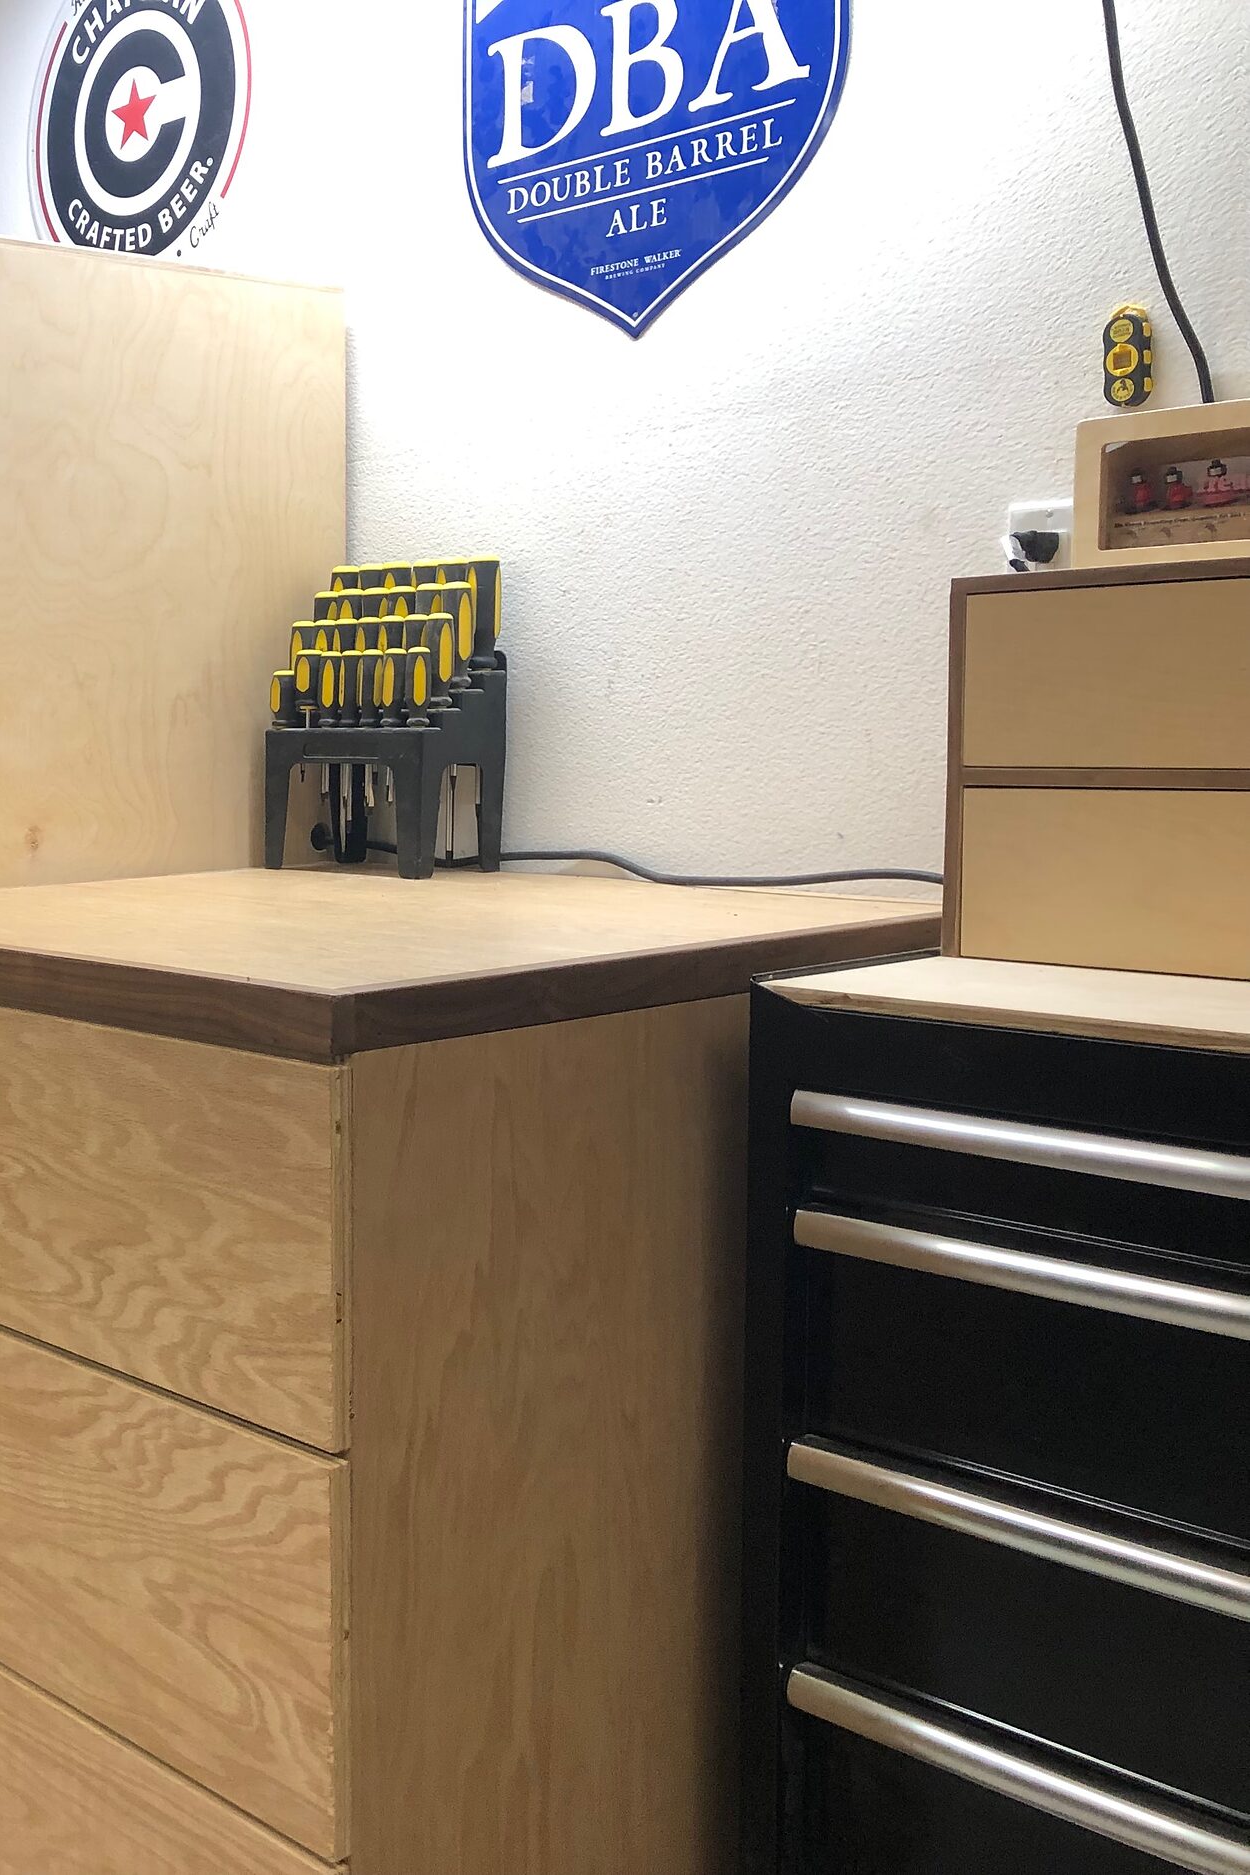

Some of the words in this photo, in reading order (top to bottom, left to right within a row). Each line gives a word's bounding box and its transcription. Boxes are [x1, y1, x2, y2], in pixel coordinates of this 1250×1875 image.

[72, 0, 206, 64] CHAN
[487, 0, 810, 168] DBA
[507, 158, 631, 215] DOUBLE
[645, 117, 783, 180] BARREL
[68, 199, 152, 252] CRAFTED
[605, 197, 668, 238] ALE
[590, 258, 639, 276] FIRESTONE
[643, 249, 681, 264] WALKER
[604, 269, 634, 280] BREWING
[635, 262, 666, 274] COMPANY
